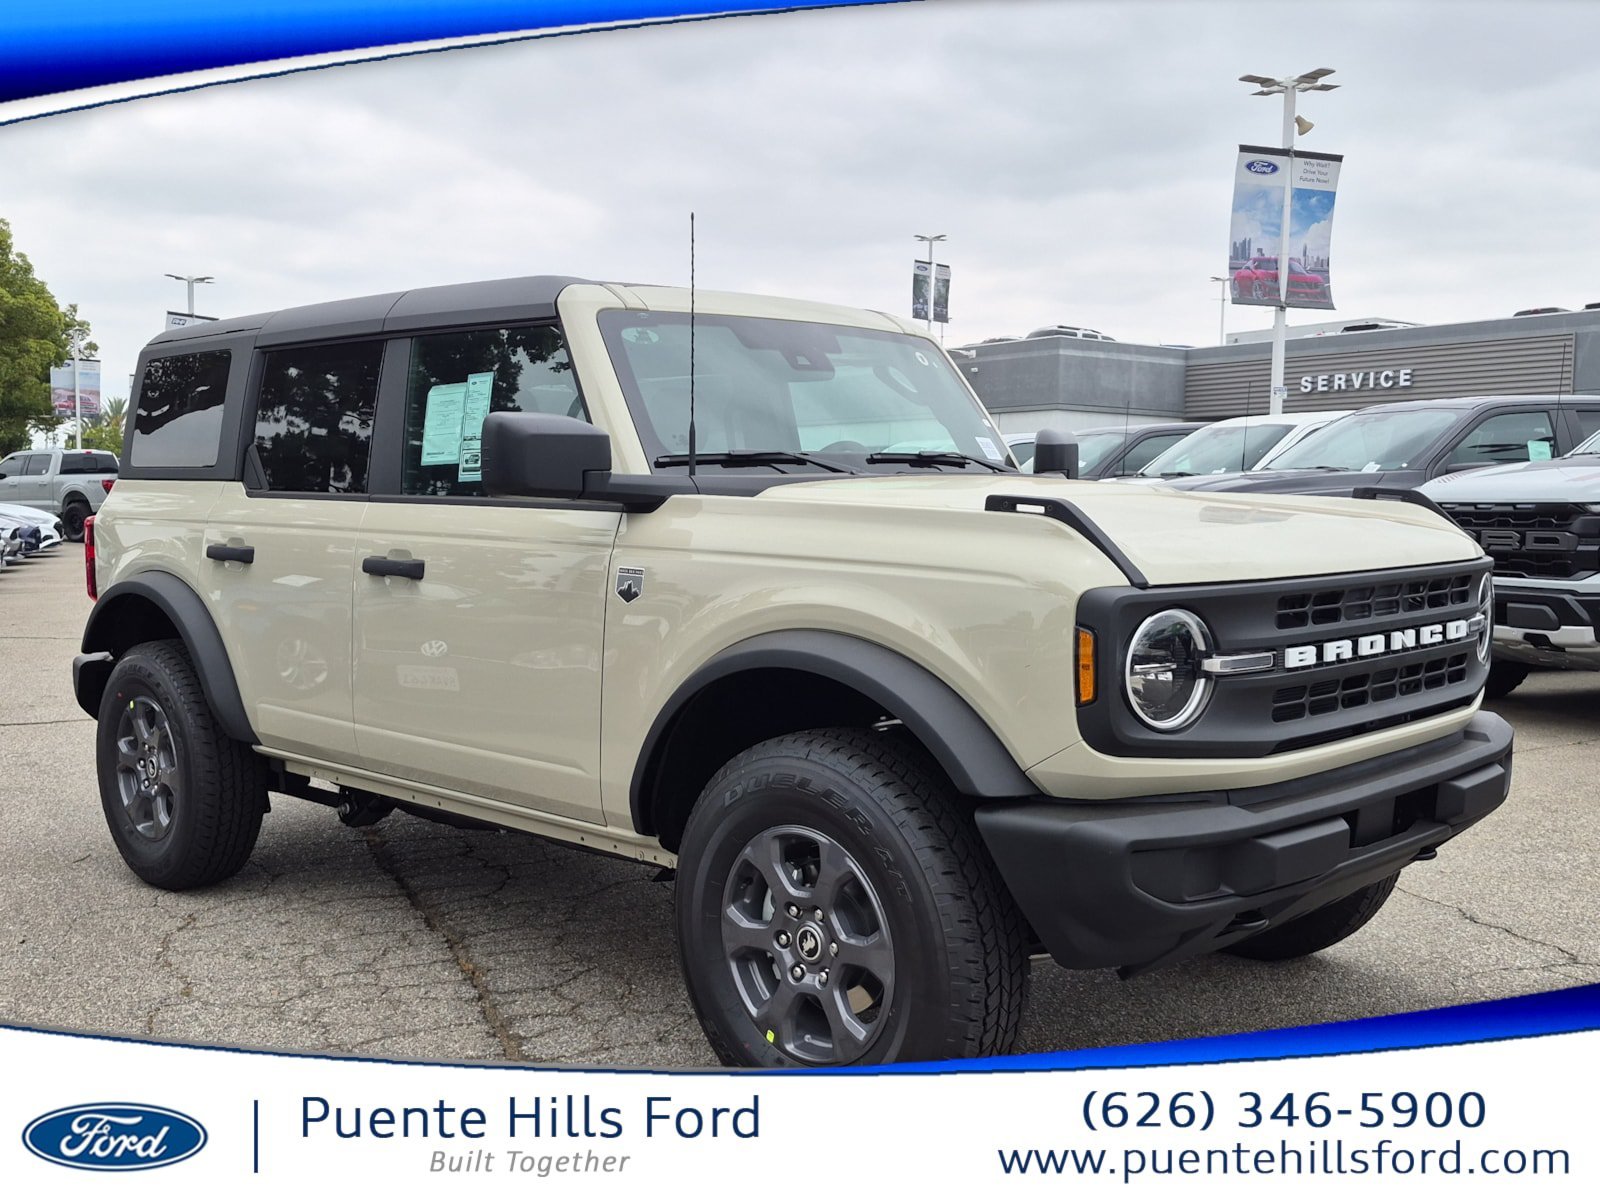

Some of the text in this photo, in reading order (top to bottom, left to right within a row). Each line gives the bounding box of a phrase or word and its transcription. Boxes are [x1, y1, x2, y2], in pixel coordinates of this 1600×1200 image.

[1303, 160, 1315, 168] Why
[1299, 175, 1315, 183] Future
[1300, 369, 1413, 393] SERVICE
[1464, 529, 1579, 551] RD
[1284, 619, 1467, 669] BRONCO
[723, 773, 874, 836] DUELER
